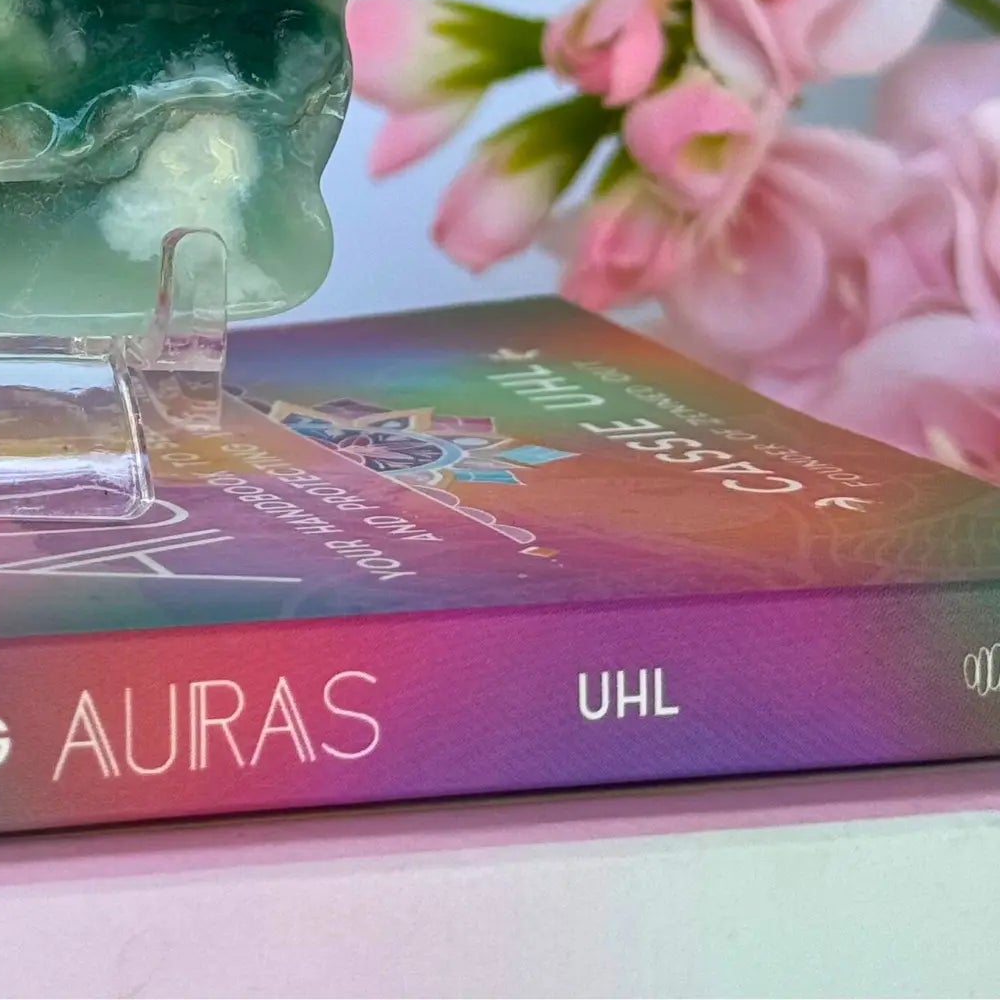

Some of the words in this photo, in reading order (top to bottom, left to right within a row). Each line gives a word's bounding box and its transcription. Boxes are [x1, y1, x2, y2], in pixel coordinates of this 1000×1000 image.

[486, 364, 605, 410] UHL
[161, 451, 223, 468] TO
[220, 443, 380, 511] PROTECTING
[577, 417, 803, 493] CASSIE
[753, 442, 880, 488] FOUNDER
[197, 470, 344, 534] HANDBOOK
[363, 515, 444, 542] AND
[325, 539, 418, 581] YOUR
[52, 671, 381, 782] AURAS
[578, 667, 680, 720] UHL
